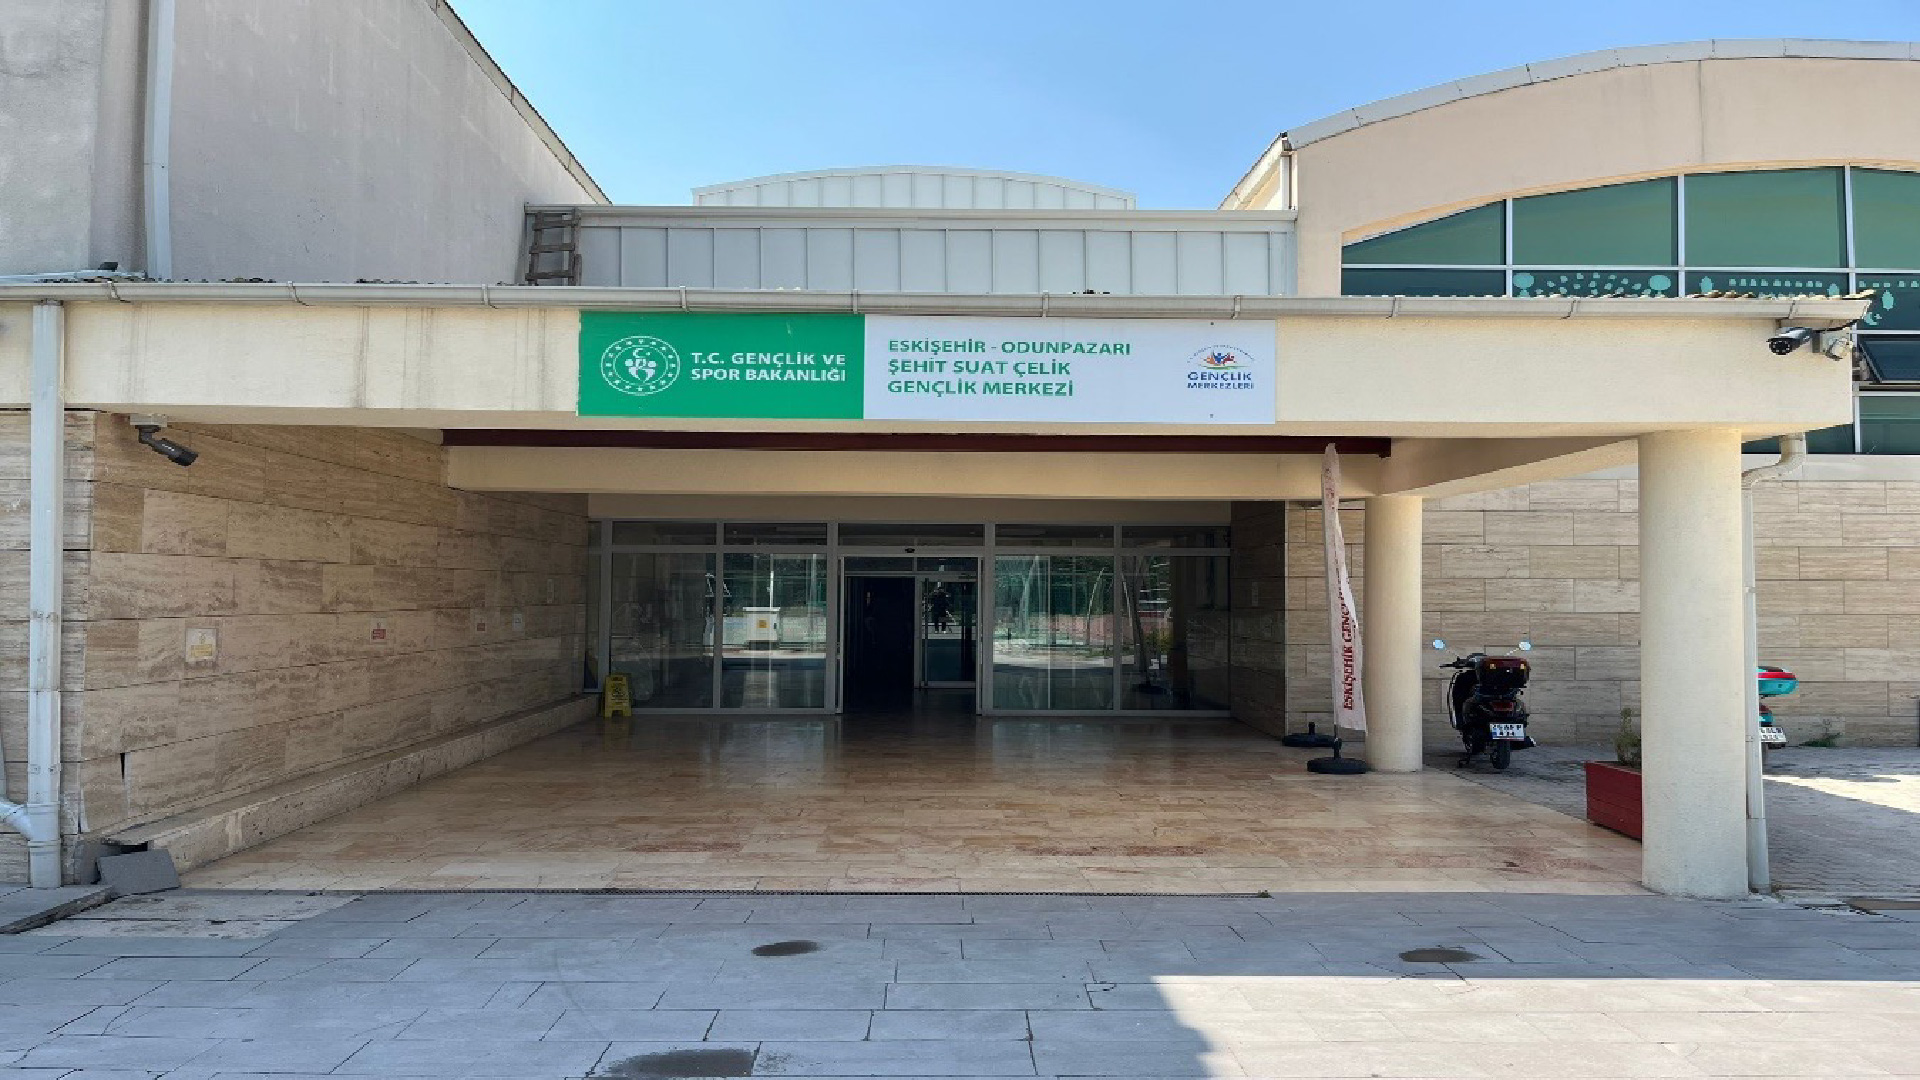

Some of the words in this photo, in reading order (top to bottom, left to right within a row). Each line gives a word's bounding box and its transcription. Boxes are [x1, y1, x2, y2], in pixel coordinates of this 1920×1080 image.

[888, 338, 986, 356] ESKİŞEHİR
[1001, 340, 1131, 356] ODUNPAZARI
[690, 352, 725, 365] T.C.
[731, 351, 816, 368] GENÇLİK
[822, 353, 847, 365] VE
[888, 358, 948, 376] ŞEHİT
[953, 360, 1009, 375] SUAT
[1012, 359, 1071, 378] ÇELİK
[690, 368, 741, 382] SPOR
[745, 366, 847, 382] BAKANLIĞI
[887, 378, 977, 398] GENÇLİK
[982, 380, 1073, 397] MERKEZİ
